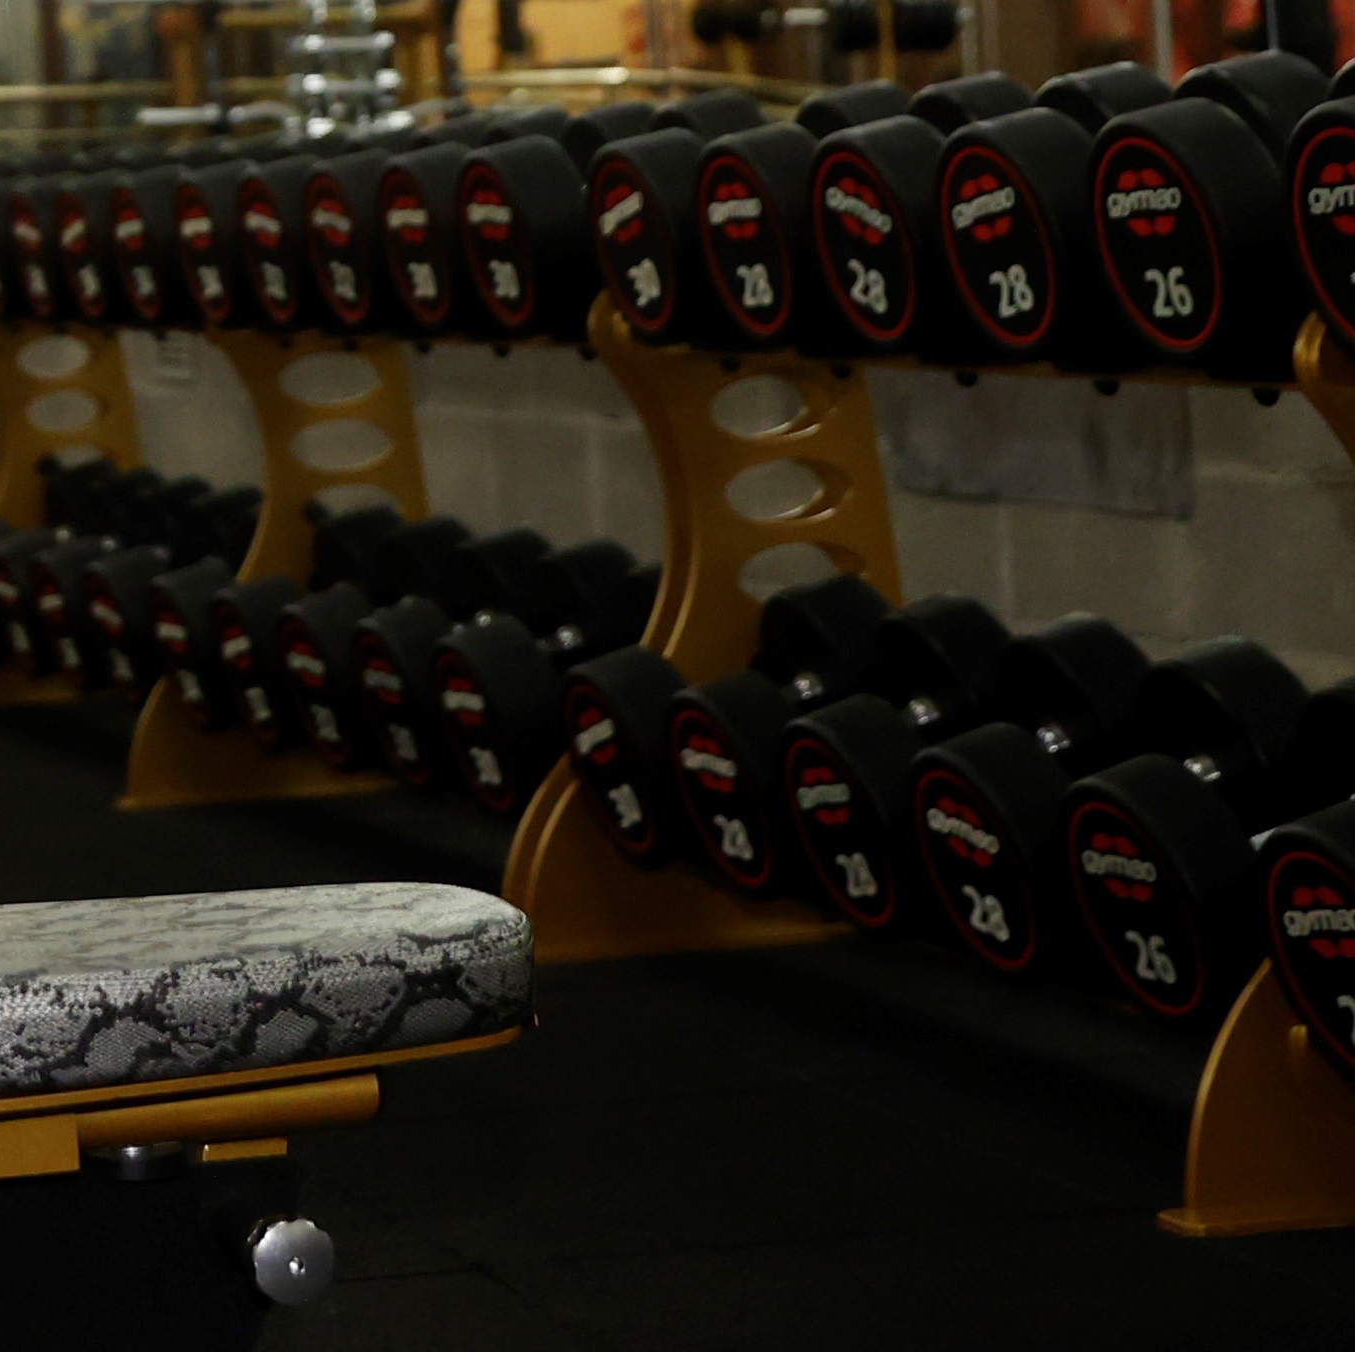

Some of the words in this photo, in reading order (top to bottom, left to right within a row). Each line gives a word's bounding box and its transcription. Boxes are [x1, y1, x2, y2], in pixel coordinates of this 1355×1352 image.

[989, 264, 1035, 318] 28
[1144, 266, 1194, 318] 26
[1124, 930, 1177, 984] 26
